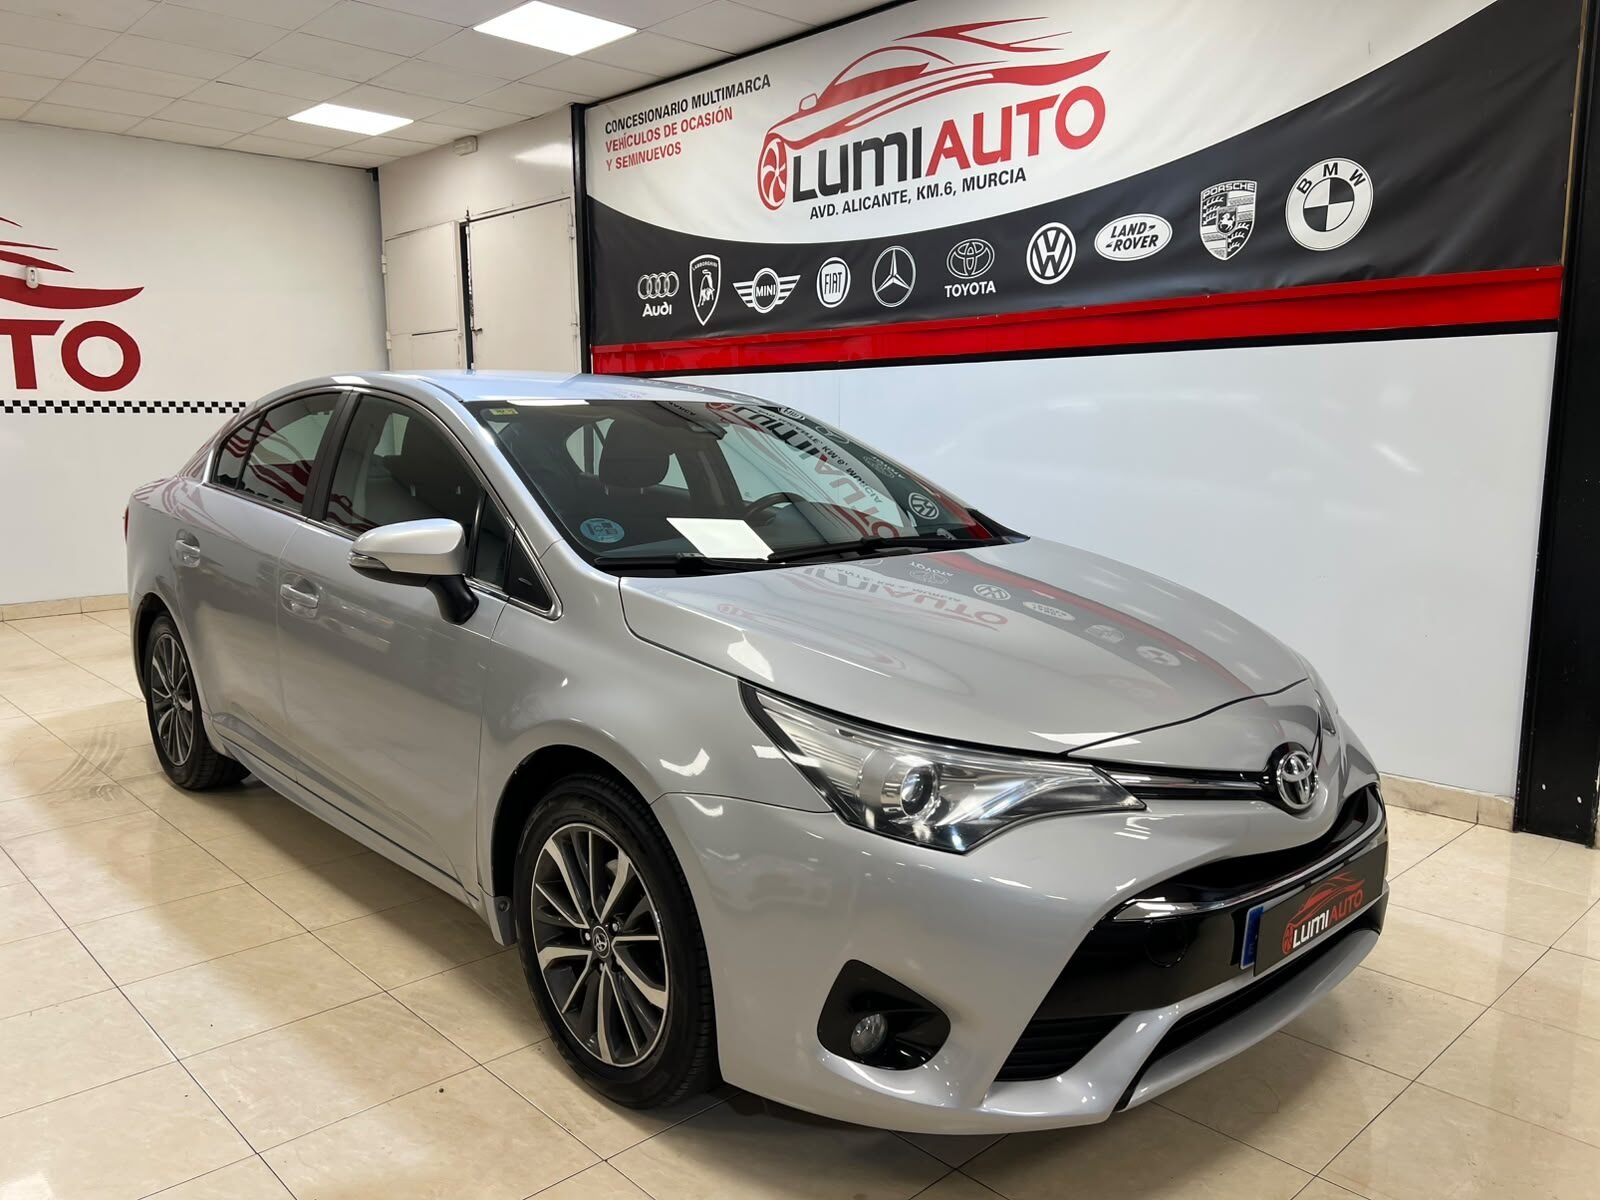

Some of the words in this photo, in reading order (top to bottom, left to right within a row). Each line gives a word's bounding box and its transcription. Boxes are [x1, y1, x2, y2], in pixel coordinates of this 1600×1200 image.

[605, 97, 688, 135] CONCESIONARIO
[691, 73, 771, 109] MULTIMARCA
[605, 125, 661, 153] VEHÍCULOS
[663, 121, 678, 137] DE
[680, 105, 733, 131] OCASIÓN
[606, 159, 614, 171] Y
[615, 141, 682, 170] SEMINUEVOS
[1202, 182, 1255, 199] PORSCHE
[1296, 162, 1366, 195] BMW
[809, 201, 839, 220] AVD.
[842, 189, 912, 214] ALICANTE,
[916, 181, 957, 200] KM.6,
[962, 167, 1027, 193] MURCIA
[755, 284, 776, 297] MINI
[824, 271, 843, 295] FIAT
[944, 280, 997, 298] TOYOTA
[642, 301, 672, 318] Audi
